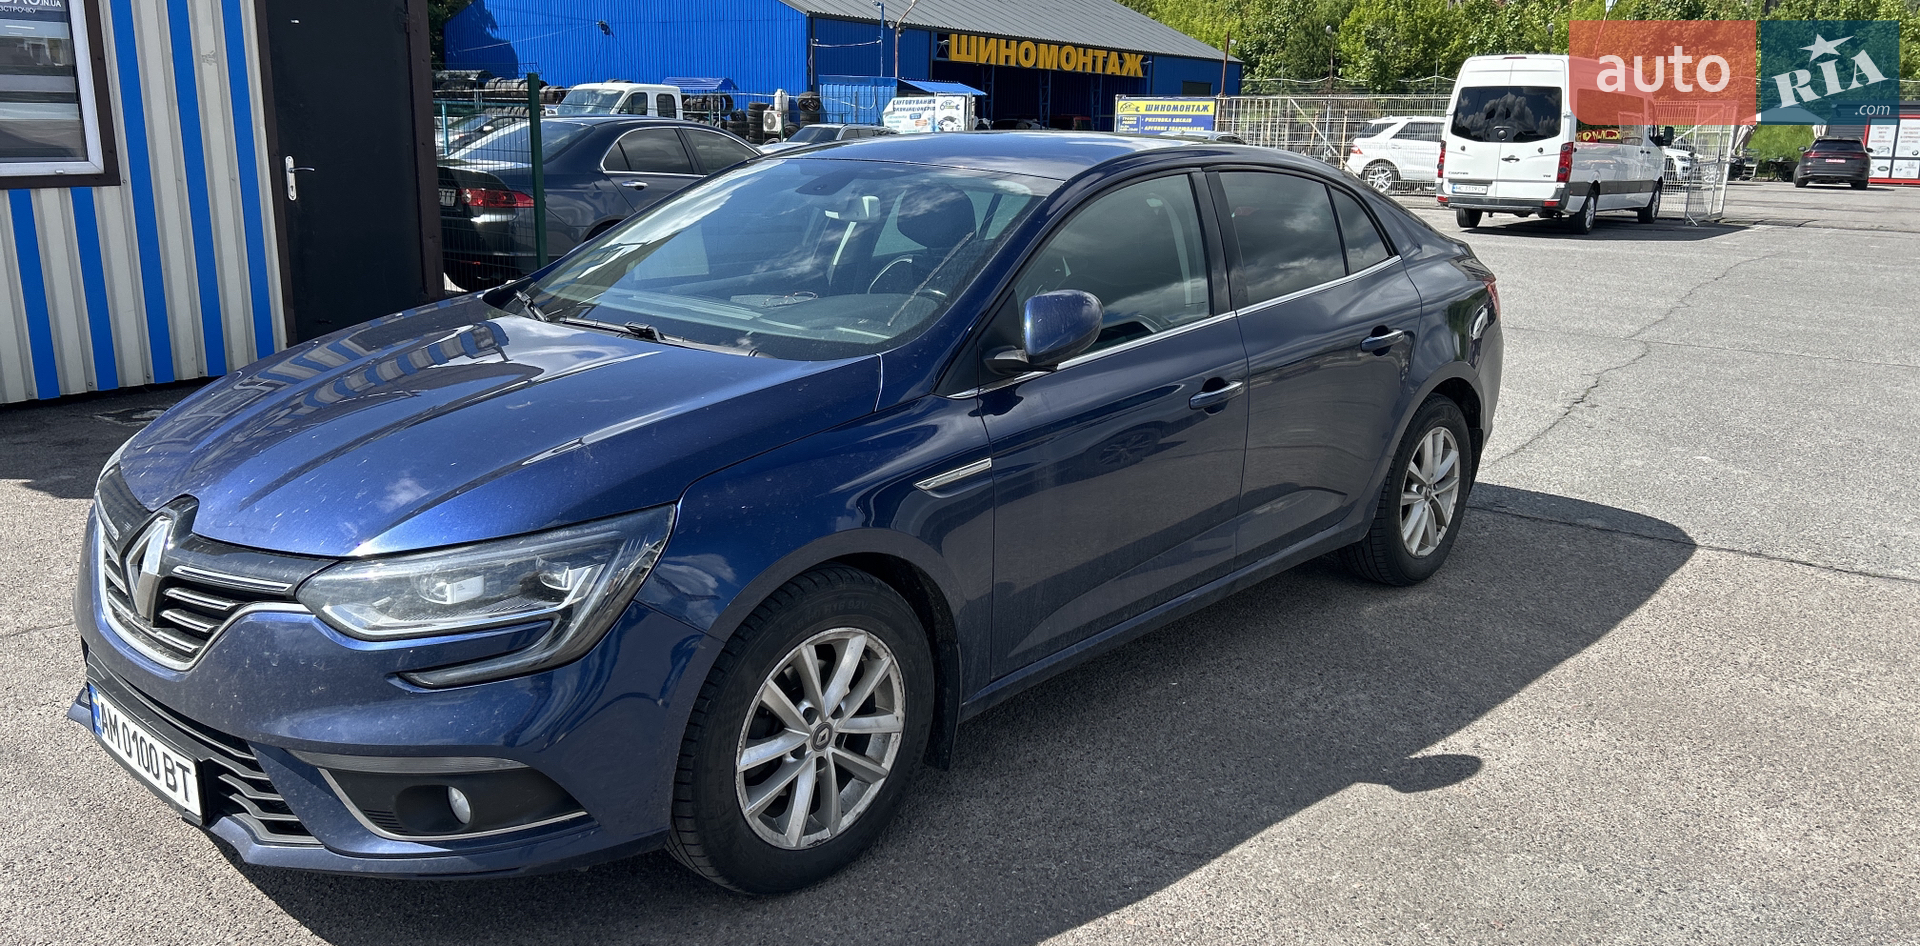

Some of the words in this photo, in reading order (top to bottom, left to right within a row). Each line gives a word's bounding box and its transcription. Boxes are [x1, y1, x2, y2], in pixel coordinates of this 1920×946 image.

[949, 33, 1144, 77] ШИНОМОНТАЖ
[1145, 104, 1209, 112] ШИНОМОНТАЖ
[101, 702, 121, 750] AM
[122, 721, 160, 780] 0100
[162, 751, 191, 802] BT
